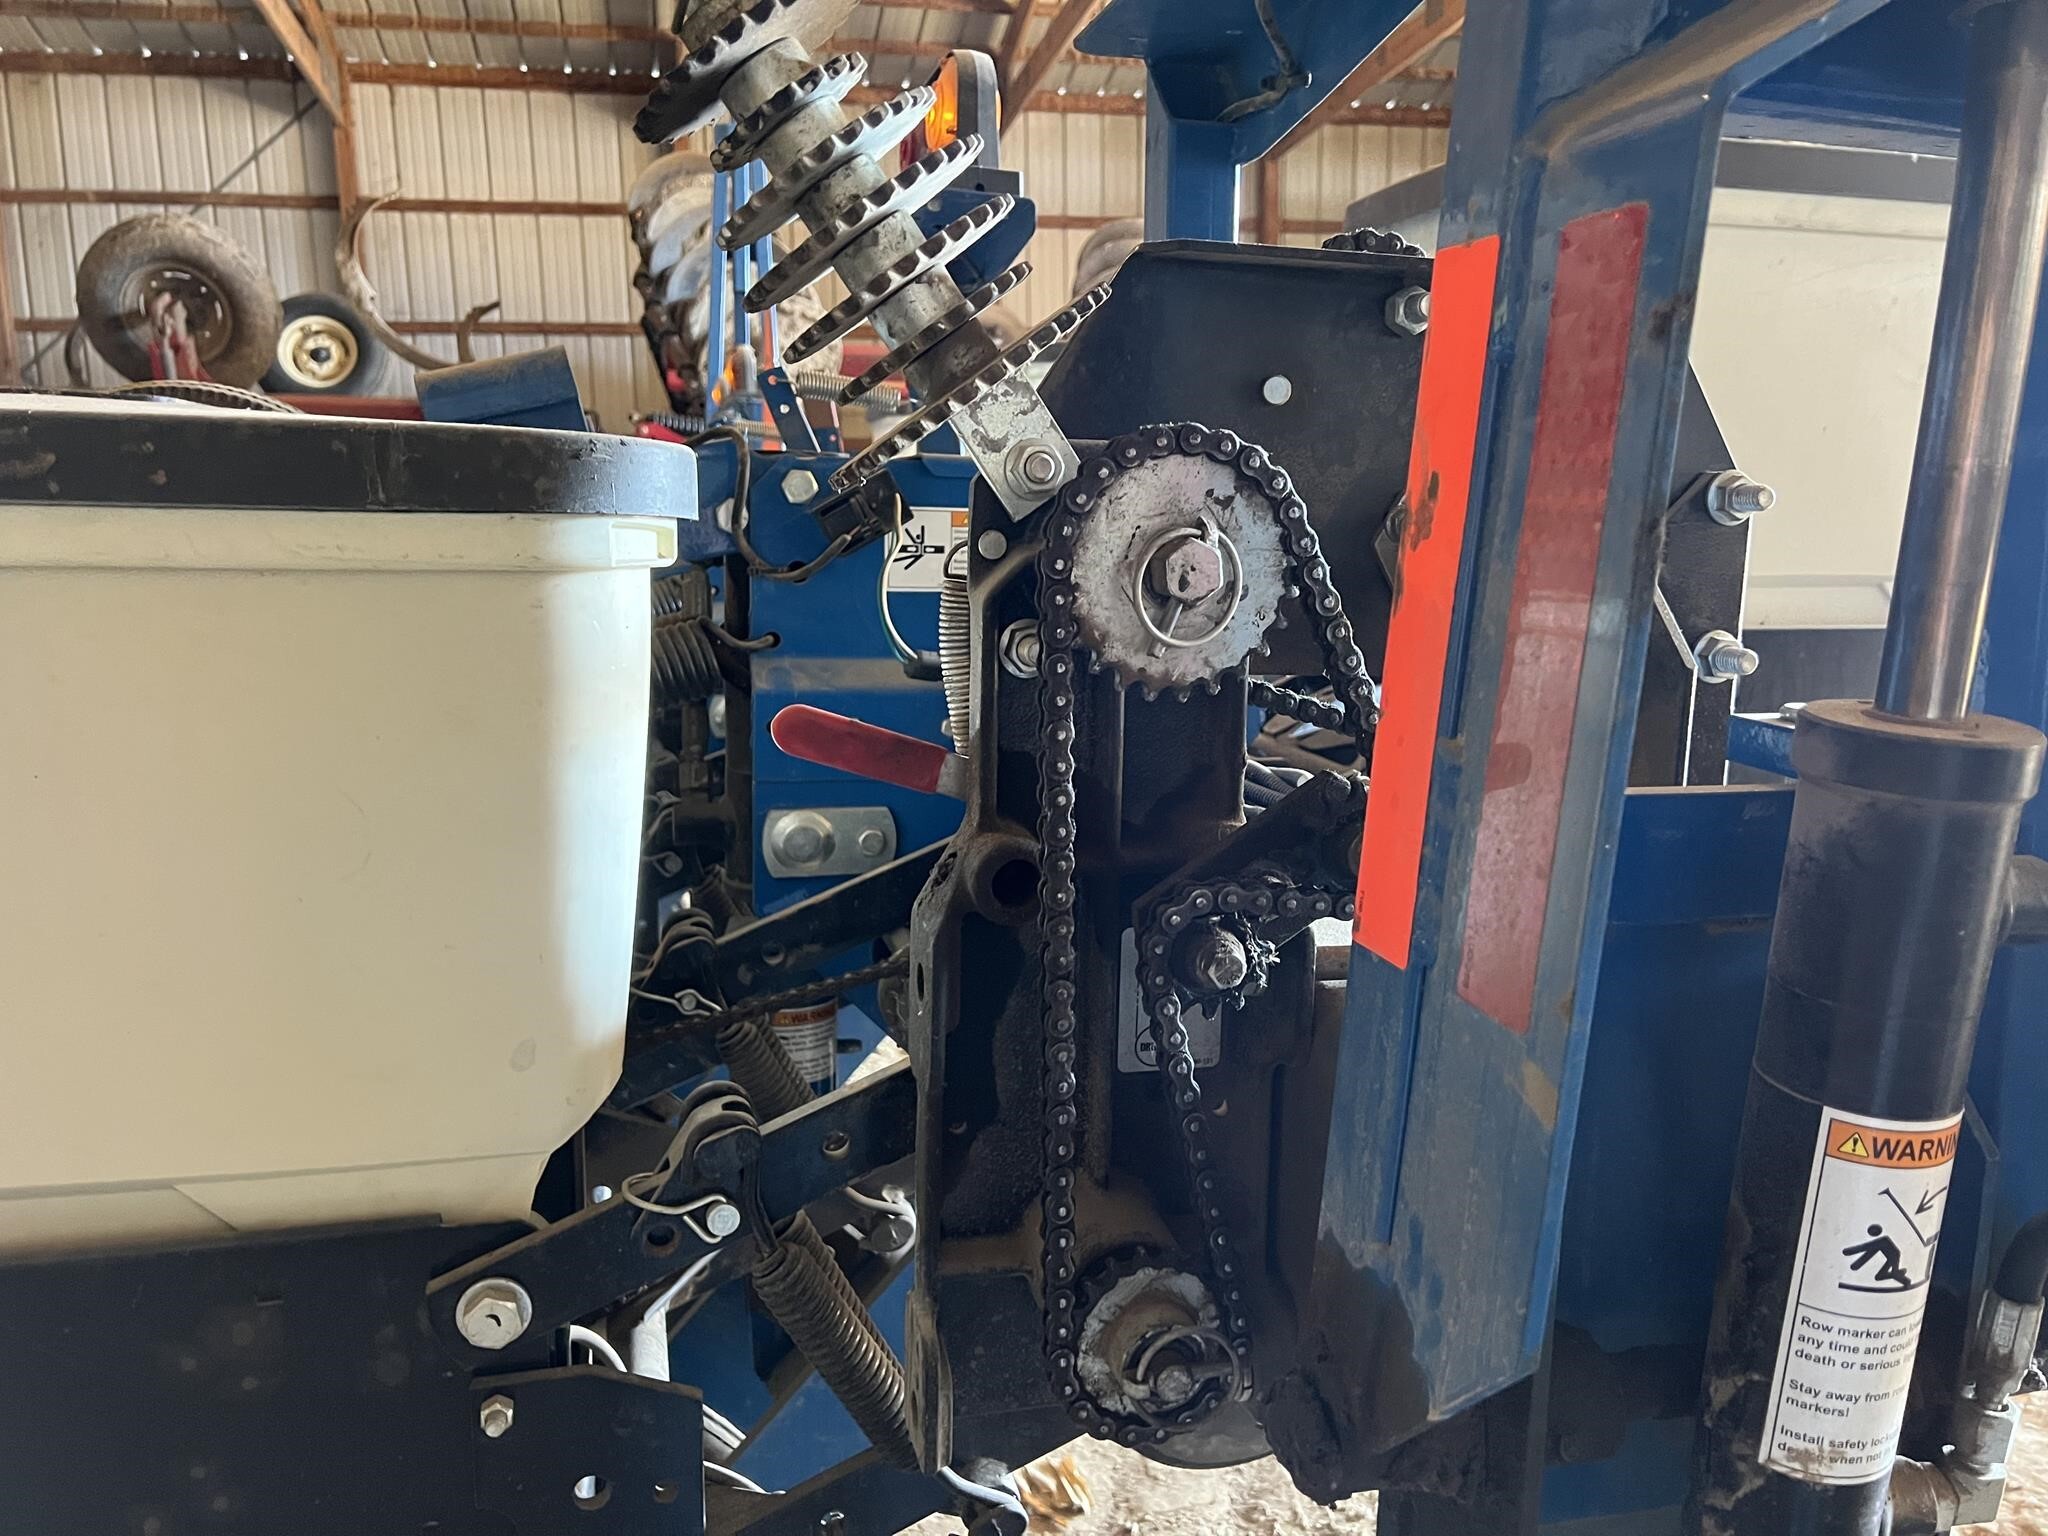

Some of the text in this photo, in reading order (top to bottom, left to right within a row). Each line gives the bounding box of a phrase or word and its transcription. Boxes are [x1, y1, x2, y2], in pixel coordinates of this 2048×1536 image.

[1800, 1315, 1907, 1339] Row marker can
[1798, 1333, 1824, 1349] any
[1829, 1340, 1860, 1355] time
[1863, 1344, 1888, 1356] and
[1794, 1347, 1836, 1367] death
[1840, 1361, 1857, 1371] or
[1859, 1357, 1901, 1371] serious
[1789, 1378, 1822, 1398] Stay
[1825, 1390, 1861, 1405] away
[1864, 1391, 1890, 1403] from
[1785, 1396, 1850, 1417] markers!
[1780, 1424, 1824, 1445] Install
[1828, 1437, 1868, 1451] safety
[1829, 1453, 1863, 1465] when
